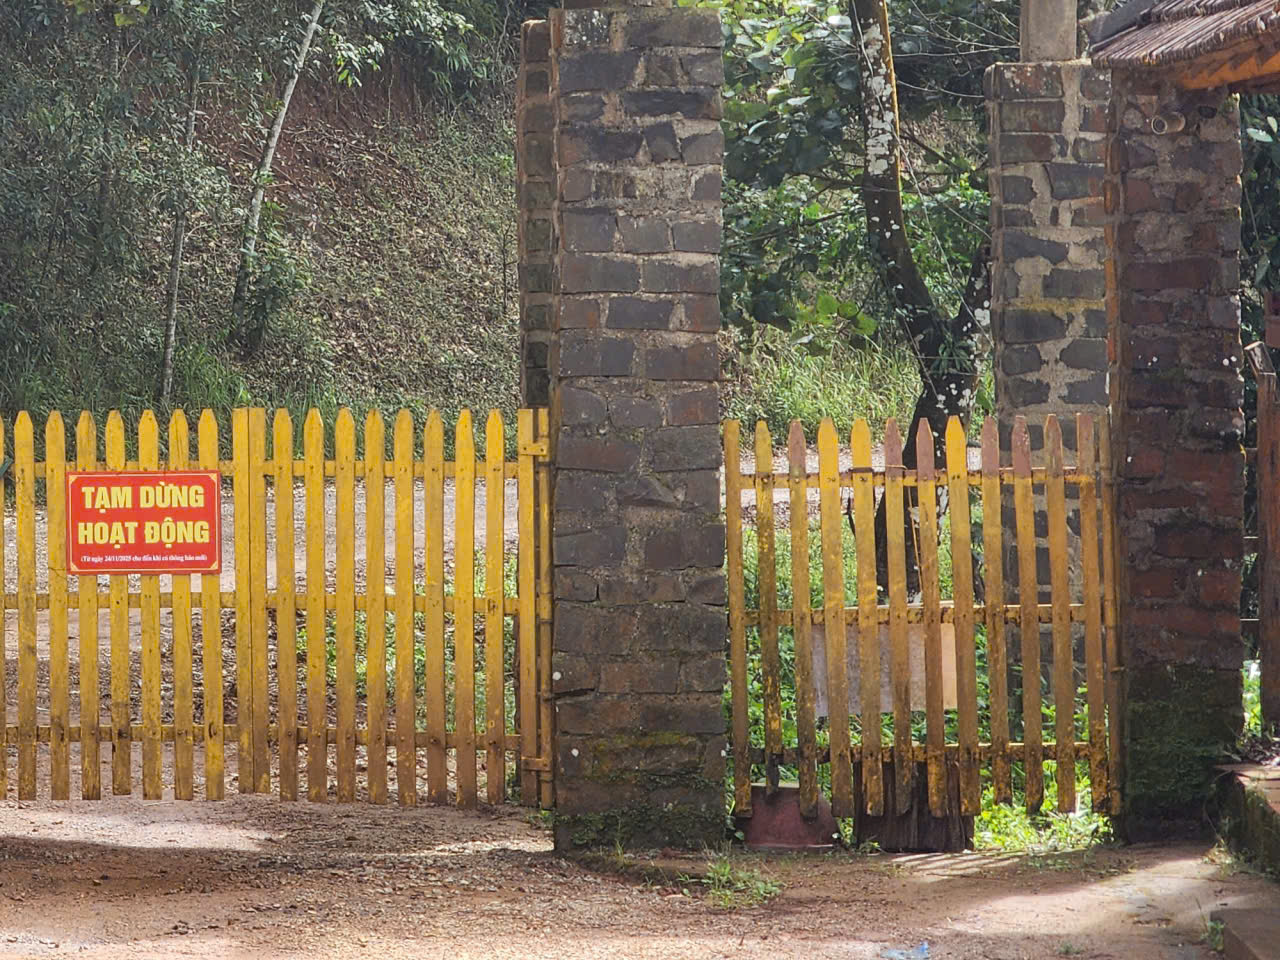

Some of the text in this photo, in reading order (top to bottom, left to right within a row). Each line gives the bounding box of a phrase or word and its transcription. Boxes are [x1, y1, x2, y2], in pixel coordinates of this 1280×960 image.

[81, 480, 205, 514] TẠM DỪNG
[78, 517, 210, 549] HOẠT ĐỘNG
